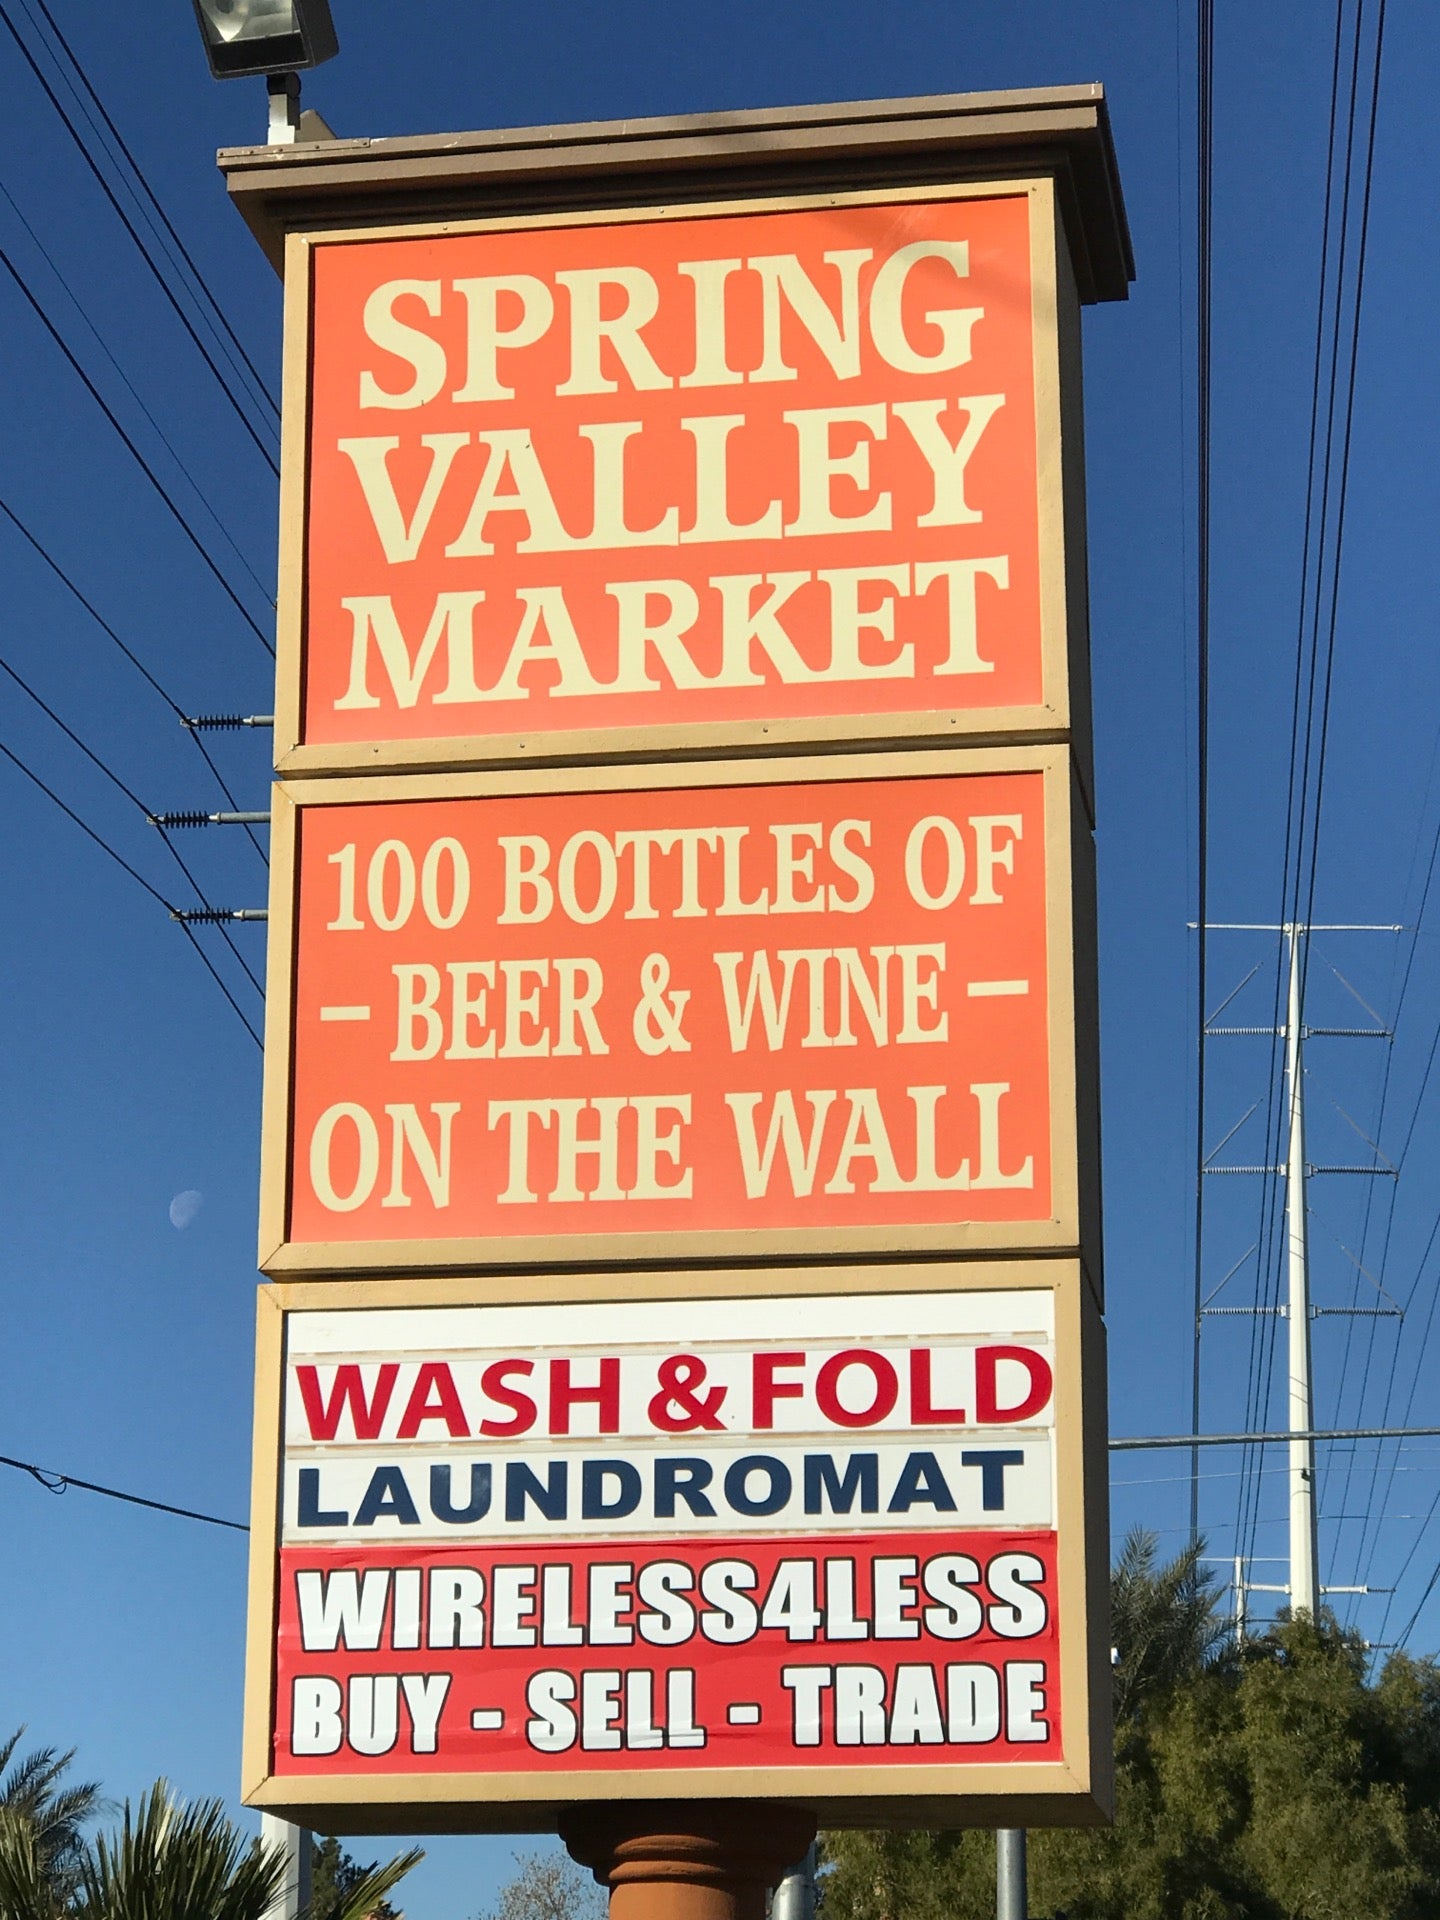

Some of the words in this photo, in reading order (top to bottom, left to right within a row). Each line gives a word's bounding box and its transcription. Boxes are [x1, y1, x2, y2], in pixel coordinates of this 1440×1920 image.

[358, 239, 985, 410] SPRING
[337, 393, 1006, 565] VALLEY
[333, 555, 1009, 710] MARKET
[326, 836, 470, 932] 100
[496, 819, 874, 926] BOTTLES
[903, 814, 1024, 911] OF
[389, 957, 610, 1063] BEER
[633, 953, 692, 1058] &
[713, 942, 949, 1054] WINE
[309, 1101, 461, 1213] ON
[488, 1093, 694, 1203] THE
[725, 1082, 1034, 1199] WALL
[295, 1358, 620, 1441] WASH
[647, 1354, 728, 1432] &
[752, 1345, 1053, 1430] FOLD
[296, 1449, 1024, 1528] LAUNDROMAT
[294, 1551, 1048, 1652] WIRELESS4LESS
[290, 1672, 452, 1758] BUY
[526, 1668, 707, 1755] SELL
[782, 1659, 1049, 1749] TRADE
